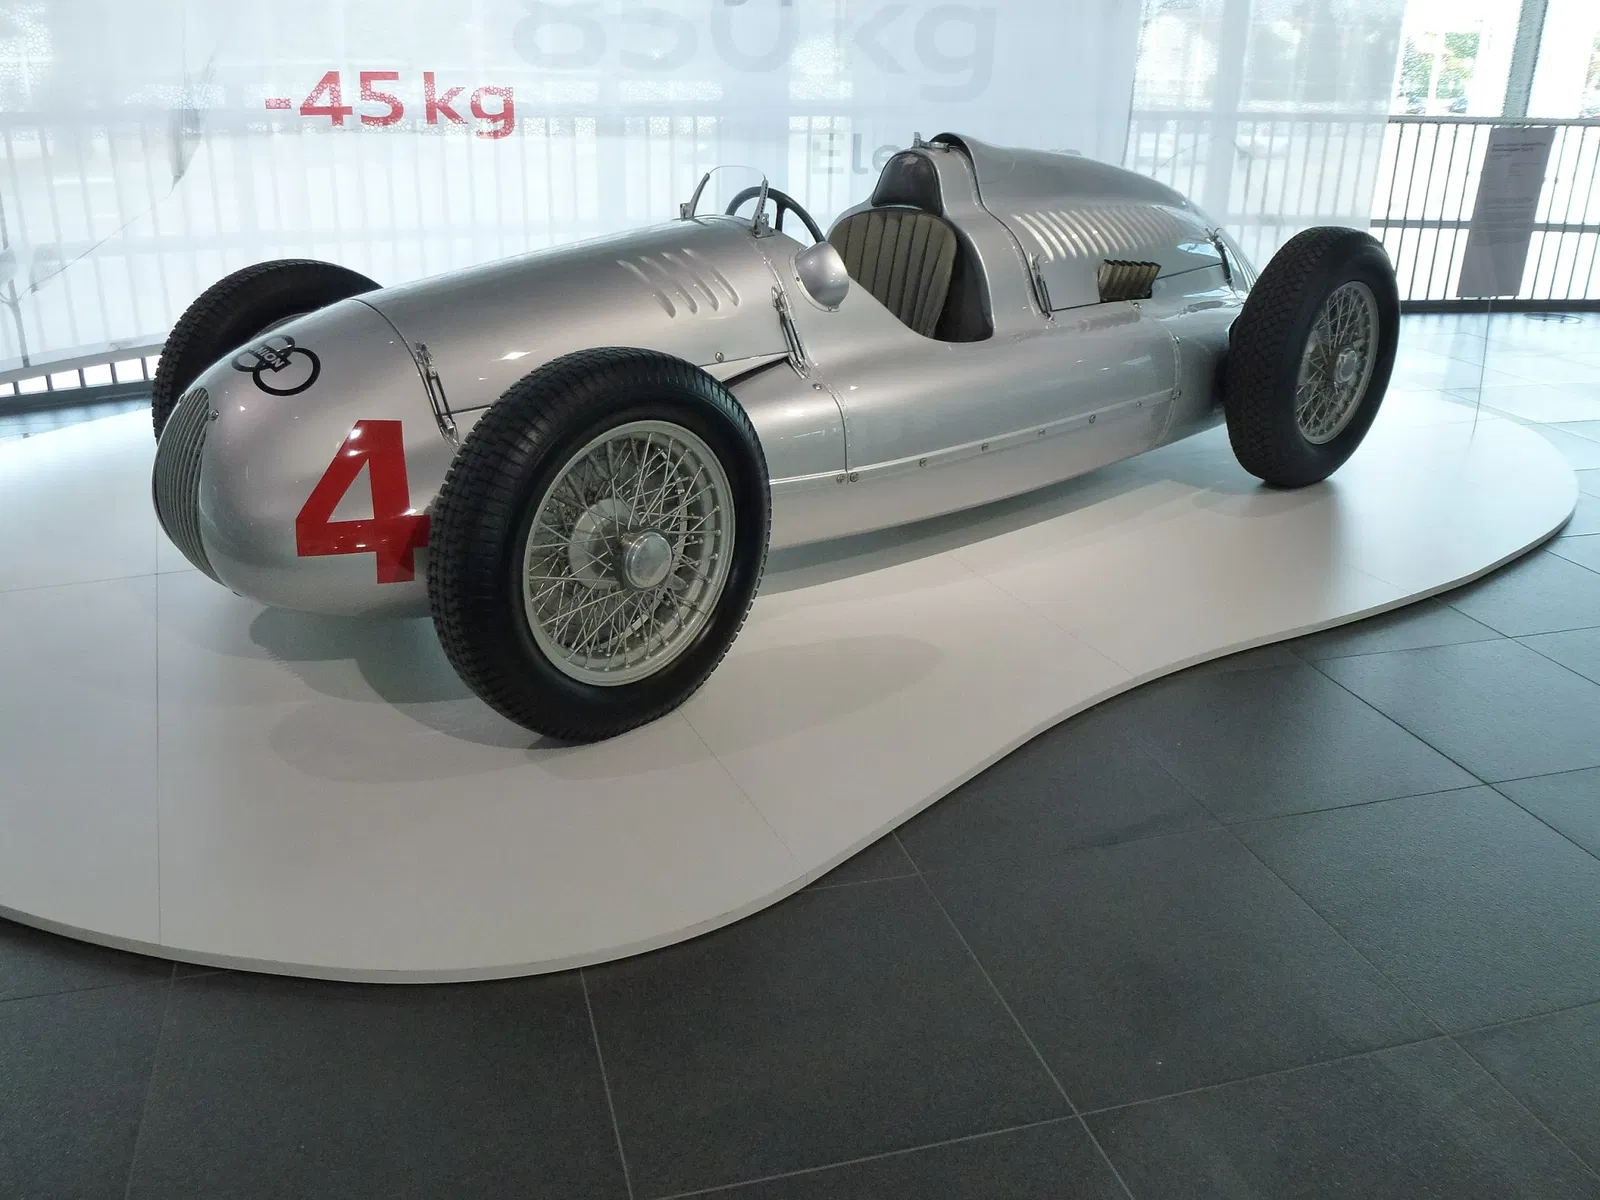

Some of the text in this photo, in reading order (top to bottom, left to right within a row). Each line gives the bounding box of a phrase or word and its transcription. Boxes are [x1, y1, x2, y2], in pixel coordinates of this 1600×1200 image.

[265, 71, 515, 140] -45 kg
[295, 419, 431, 584] 4
